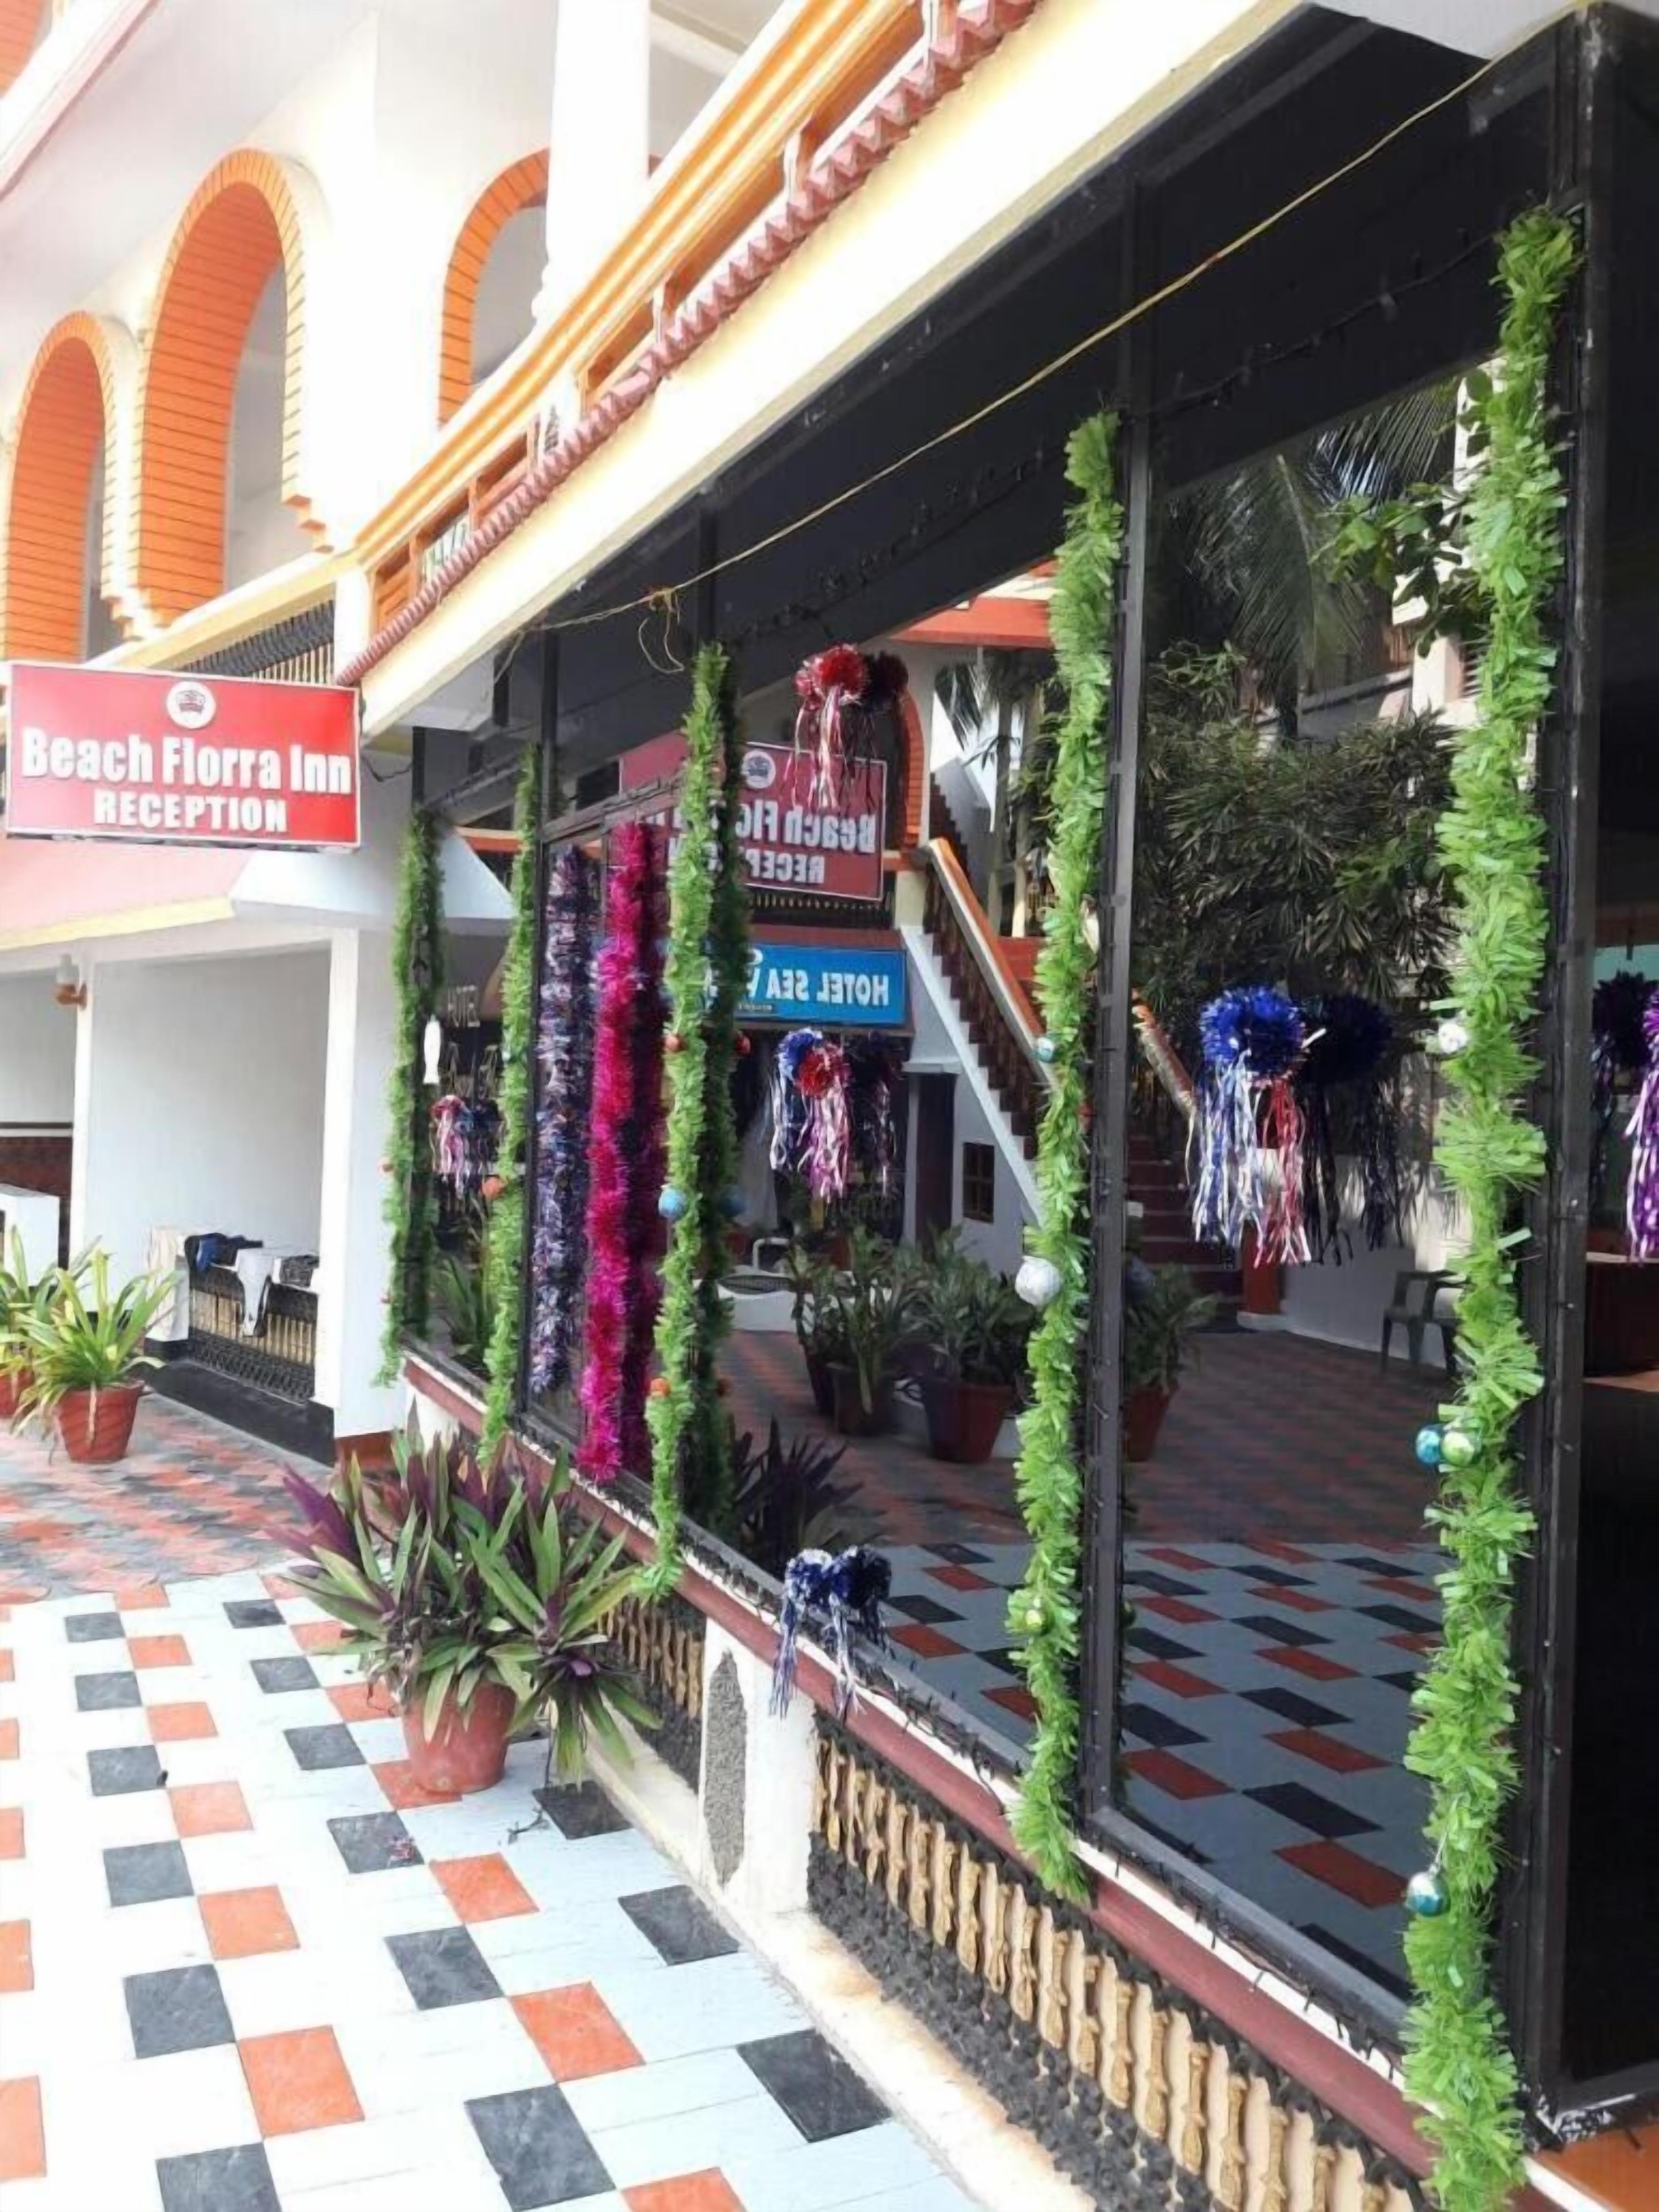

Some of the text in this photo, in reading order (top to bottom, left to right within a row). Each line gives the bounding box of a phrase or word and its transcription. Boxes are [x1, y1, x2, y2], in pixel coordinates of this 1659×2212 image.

[22, 727, 351, 795] Beach Florra Inn
[94, 789, 287, 832] RECEPTION
